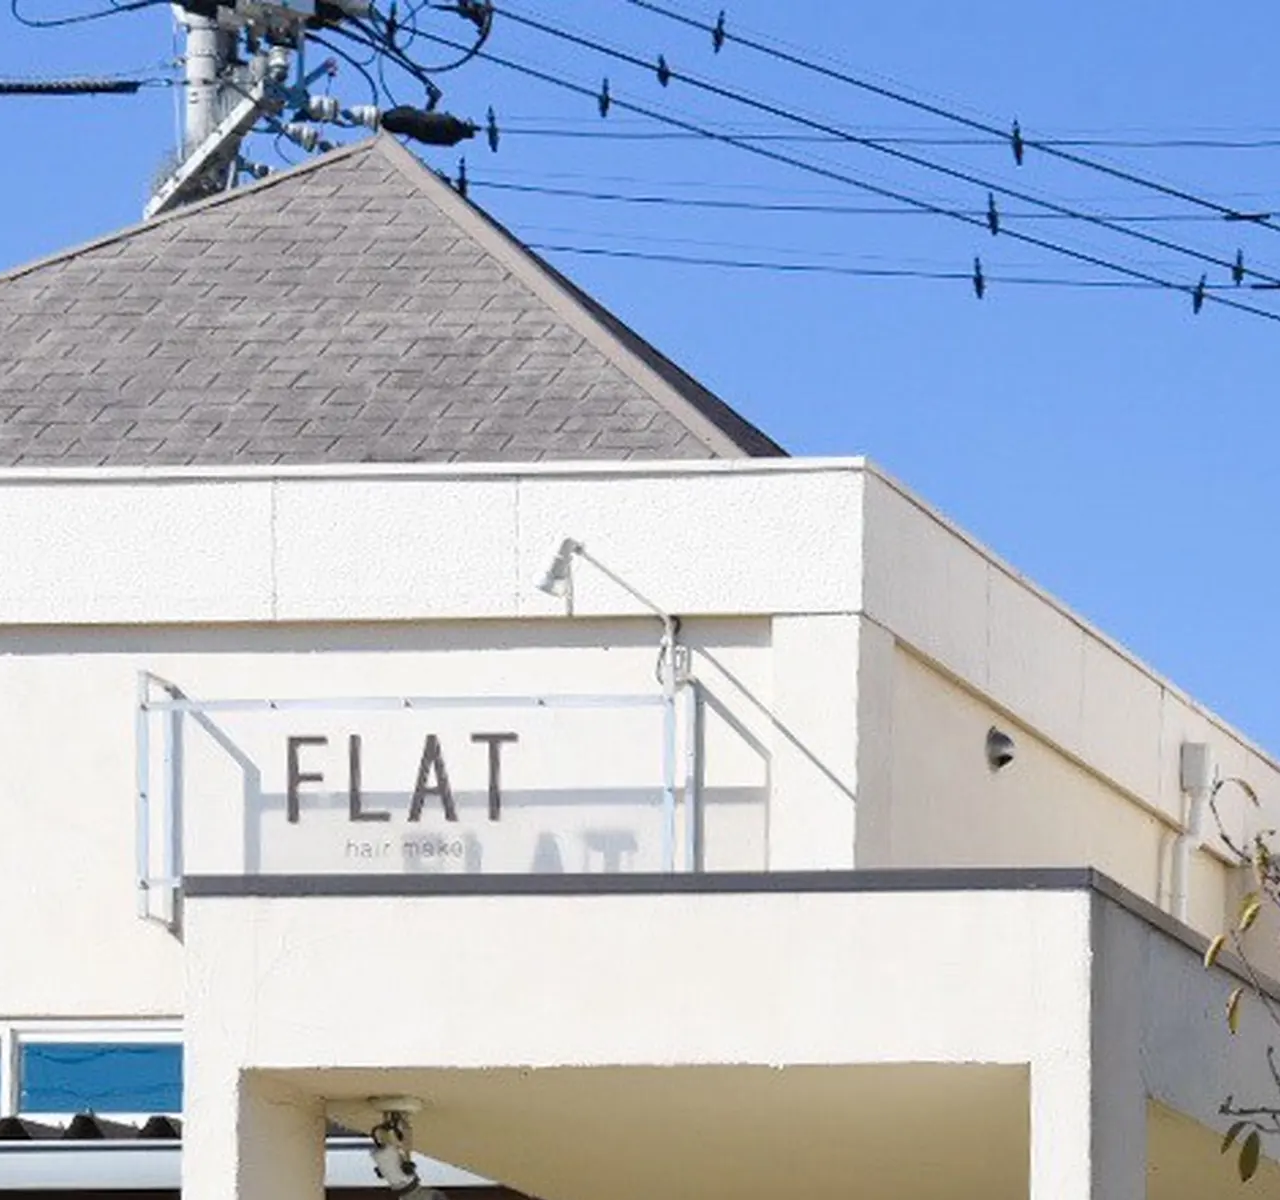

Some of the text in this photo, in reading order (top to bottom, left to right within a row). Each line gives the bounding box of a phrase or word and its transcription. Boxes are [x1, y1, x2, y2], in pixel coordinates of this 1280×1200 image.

[287, 732, 519, 824] FLAT
[345, 837, 464, 858] hair make
